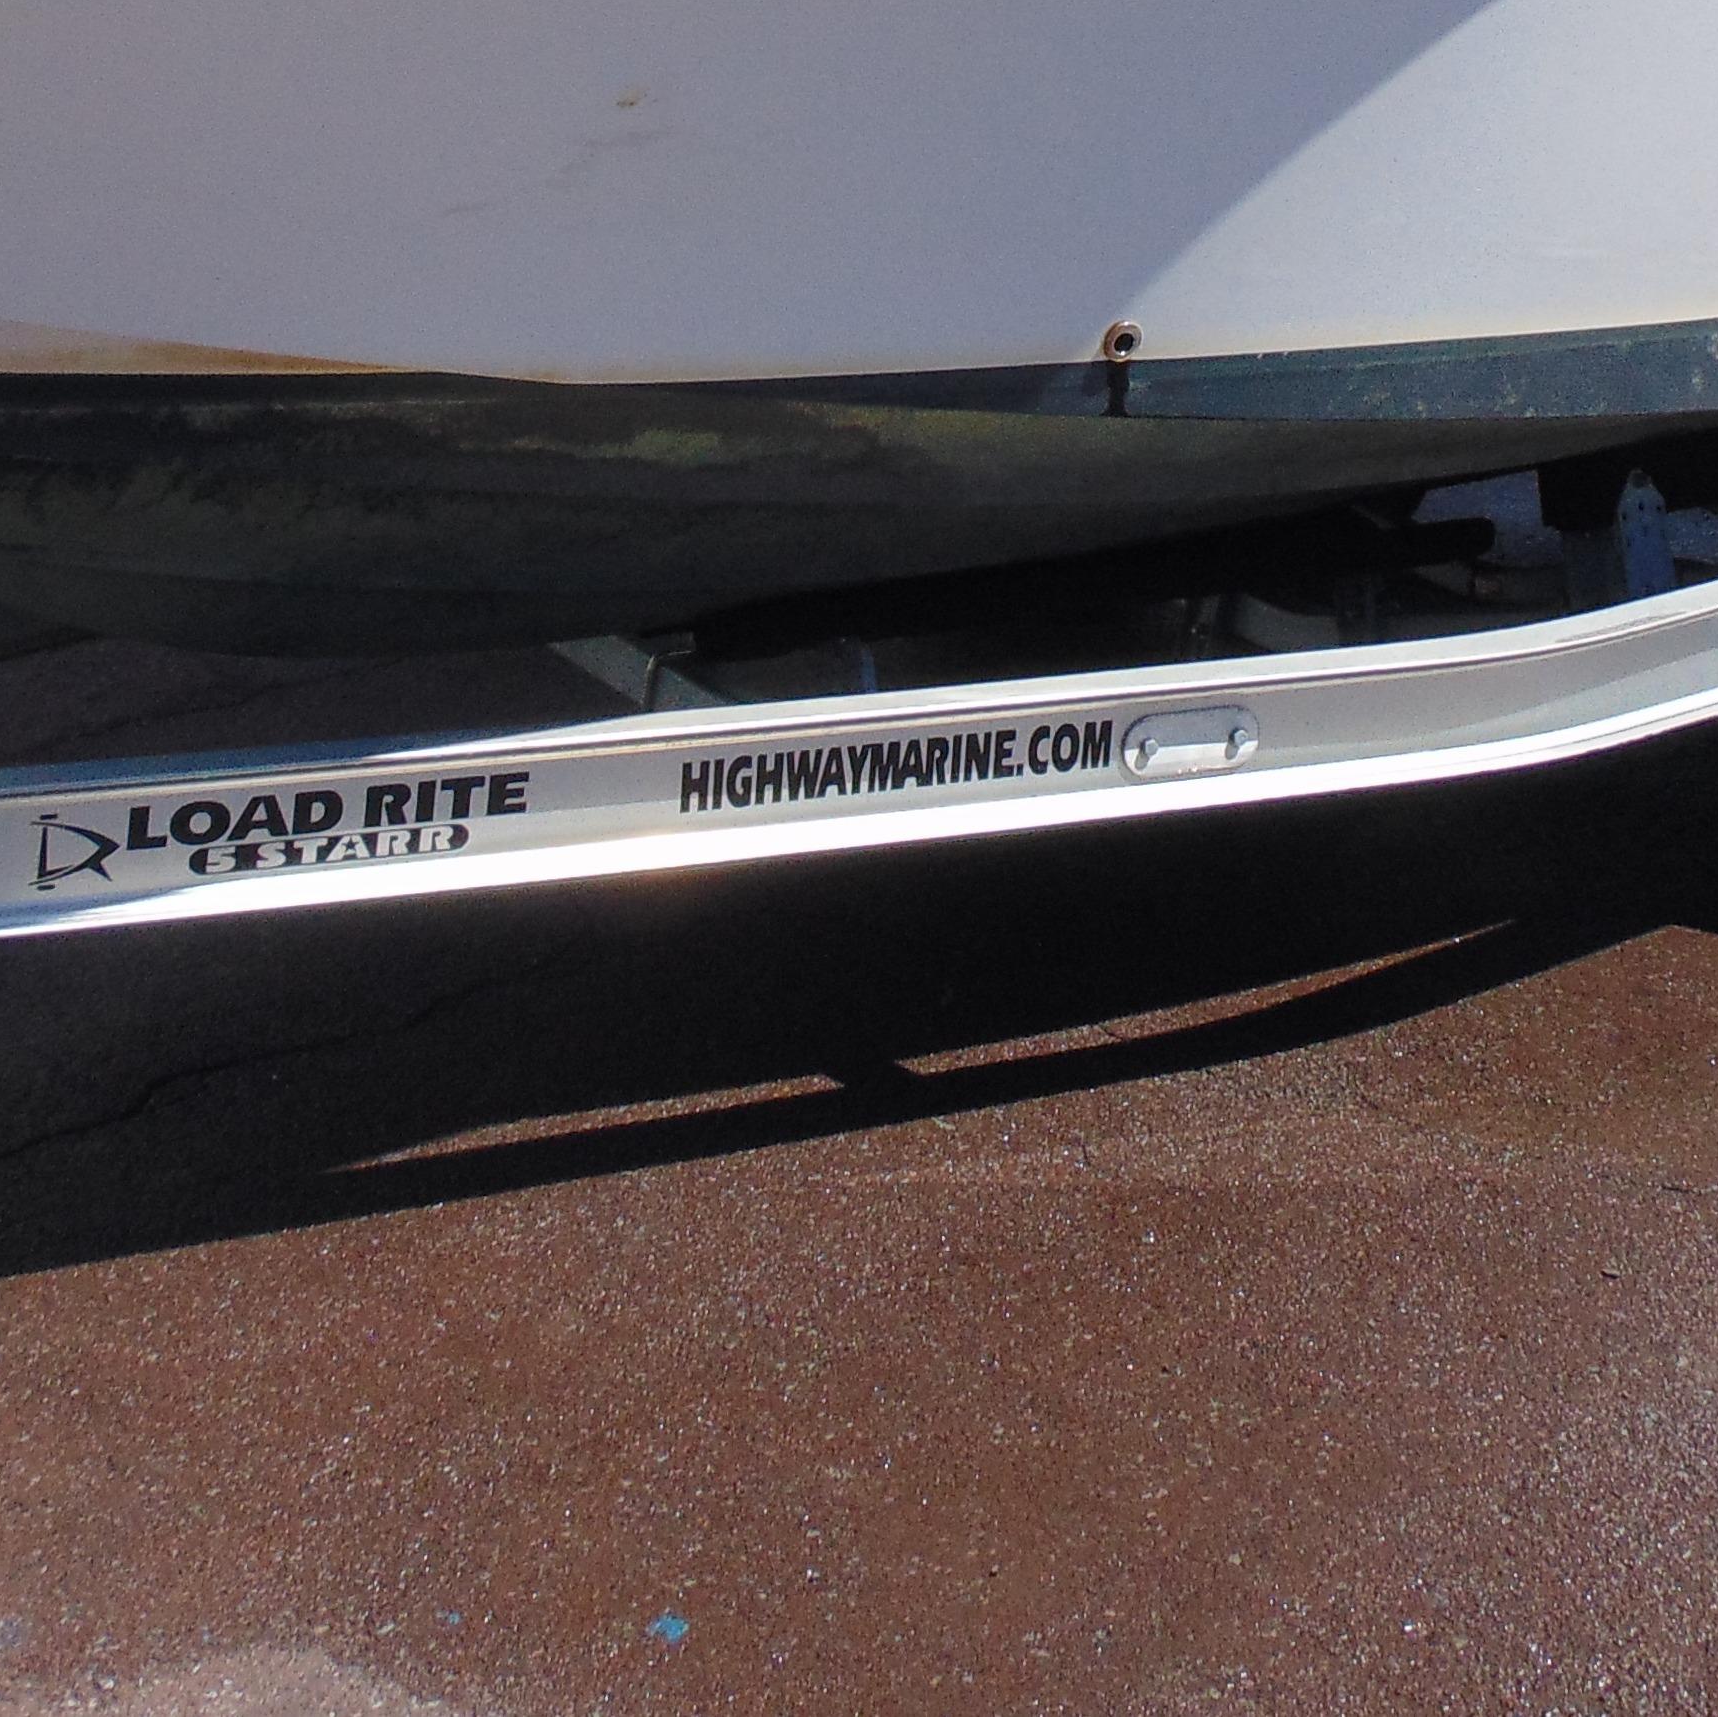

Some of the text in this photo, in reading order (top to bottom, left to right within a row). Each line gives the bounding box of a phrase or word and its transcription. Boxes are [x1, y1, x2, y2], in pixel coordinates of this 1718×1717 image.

[678, 719, 1114, 814] HIGHWAYMARINE.COM
[126, 770, 531, 851] LOAD RITE
[204, 824, 456, 874] 5 STARR
